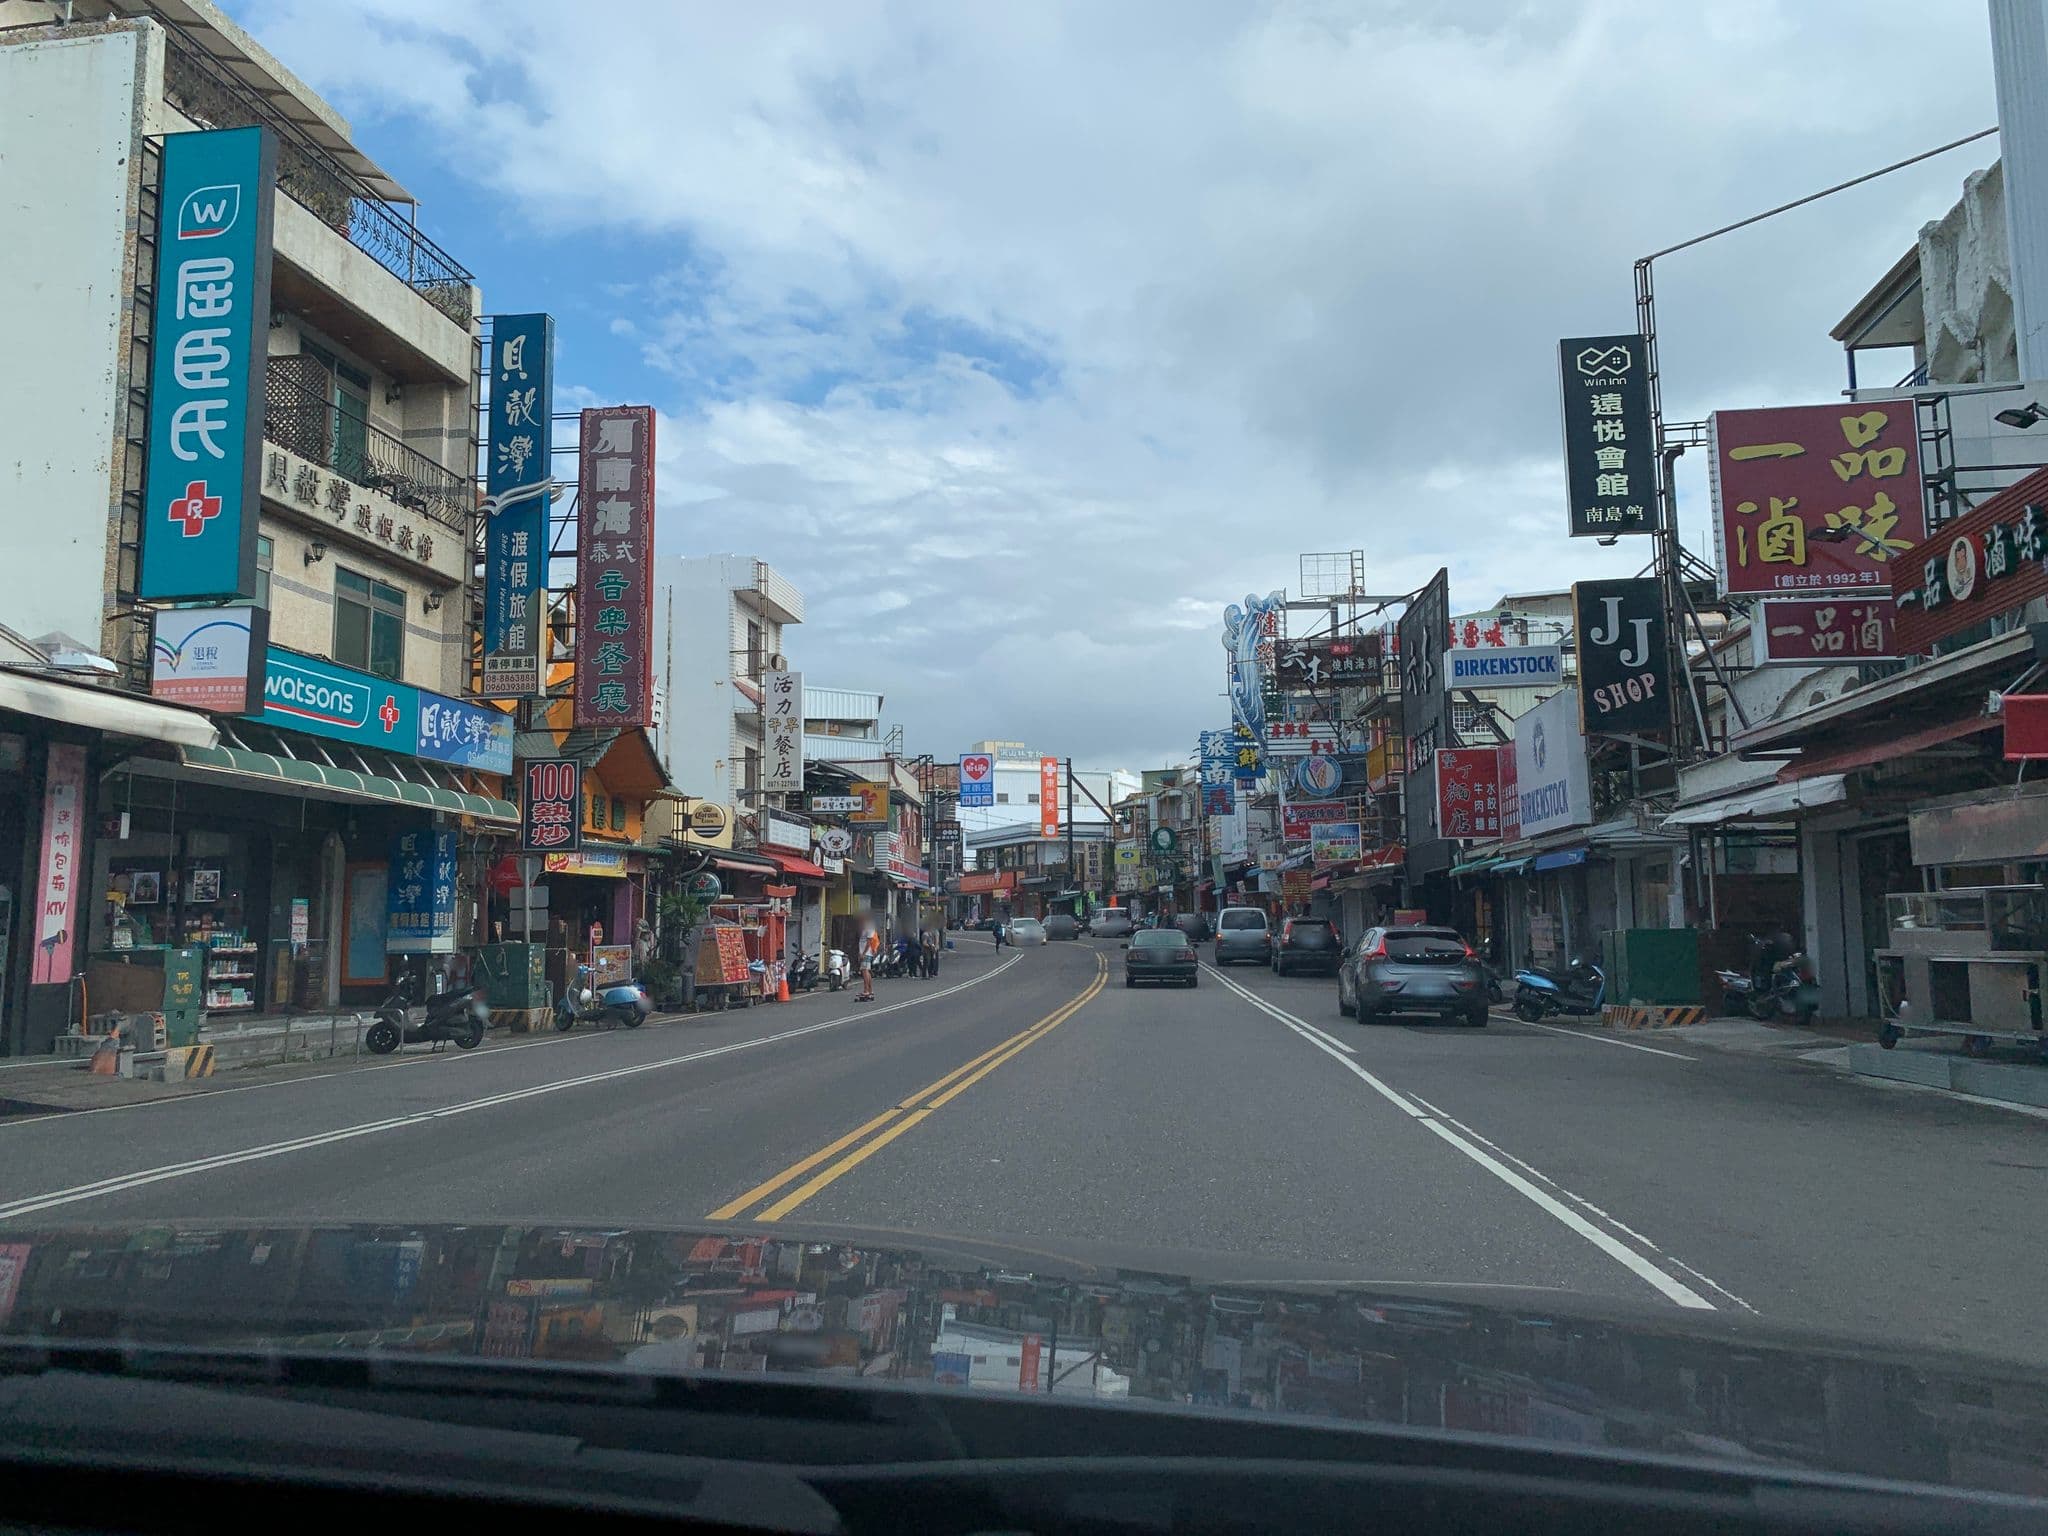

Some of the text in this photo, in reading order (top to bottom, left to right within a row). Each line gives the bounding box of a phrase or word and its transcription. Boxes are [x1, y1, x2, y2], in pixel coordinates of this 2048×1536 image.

[170, 258, 235, 462] 屈臣氏
[1584, 377, 1627, 387] Win Inn
[497, 334, 541, 486] 貝殼灣
[1590, 392, 1629, 497] 遠悅會館
[1728, 411, 1906, 481] 一品
[590, 541, 637, 564] 泰式
[1736, 492, 1915, 568] 滷味
[509, 531, 529, 651] 渡假旅館
[1896, 557, 1941, 612] 一品
[591, 570, 632, 714] 音樂餐廳
[1771, 606, 1896, 652] 一品滷
[488, 658, 535, 671] 備停車場
[1454, 655, 1557, 677] BIRKENSTOCK
[265, 675, 353, 714] watsons
[1594, 672, 1655, 713] SHOP
[420, 703, 485, 752] 貝殼灣
[530, 763, 575, 801] 100
[1521, 778, 1570, 827] BIRKENSTOCK
[531, 802, 572, 846] 熱炒
[695, 811, 719, 820] Corona
[46, 901, 66, 915] KTV
